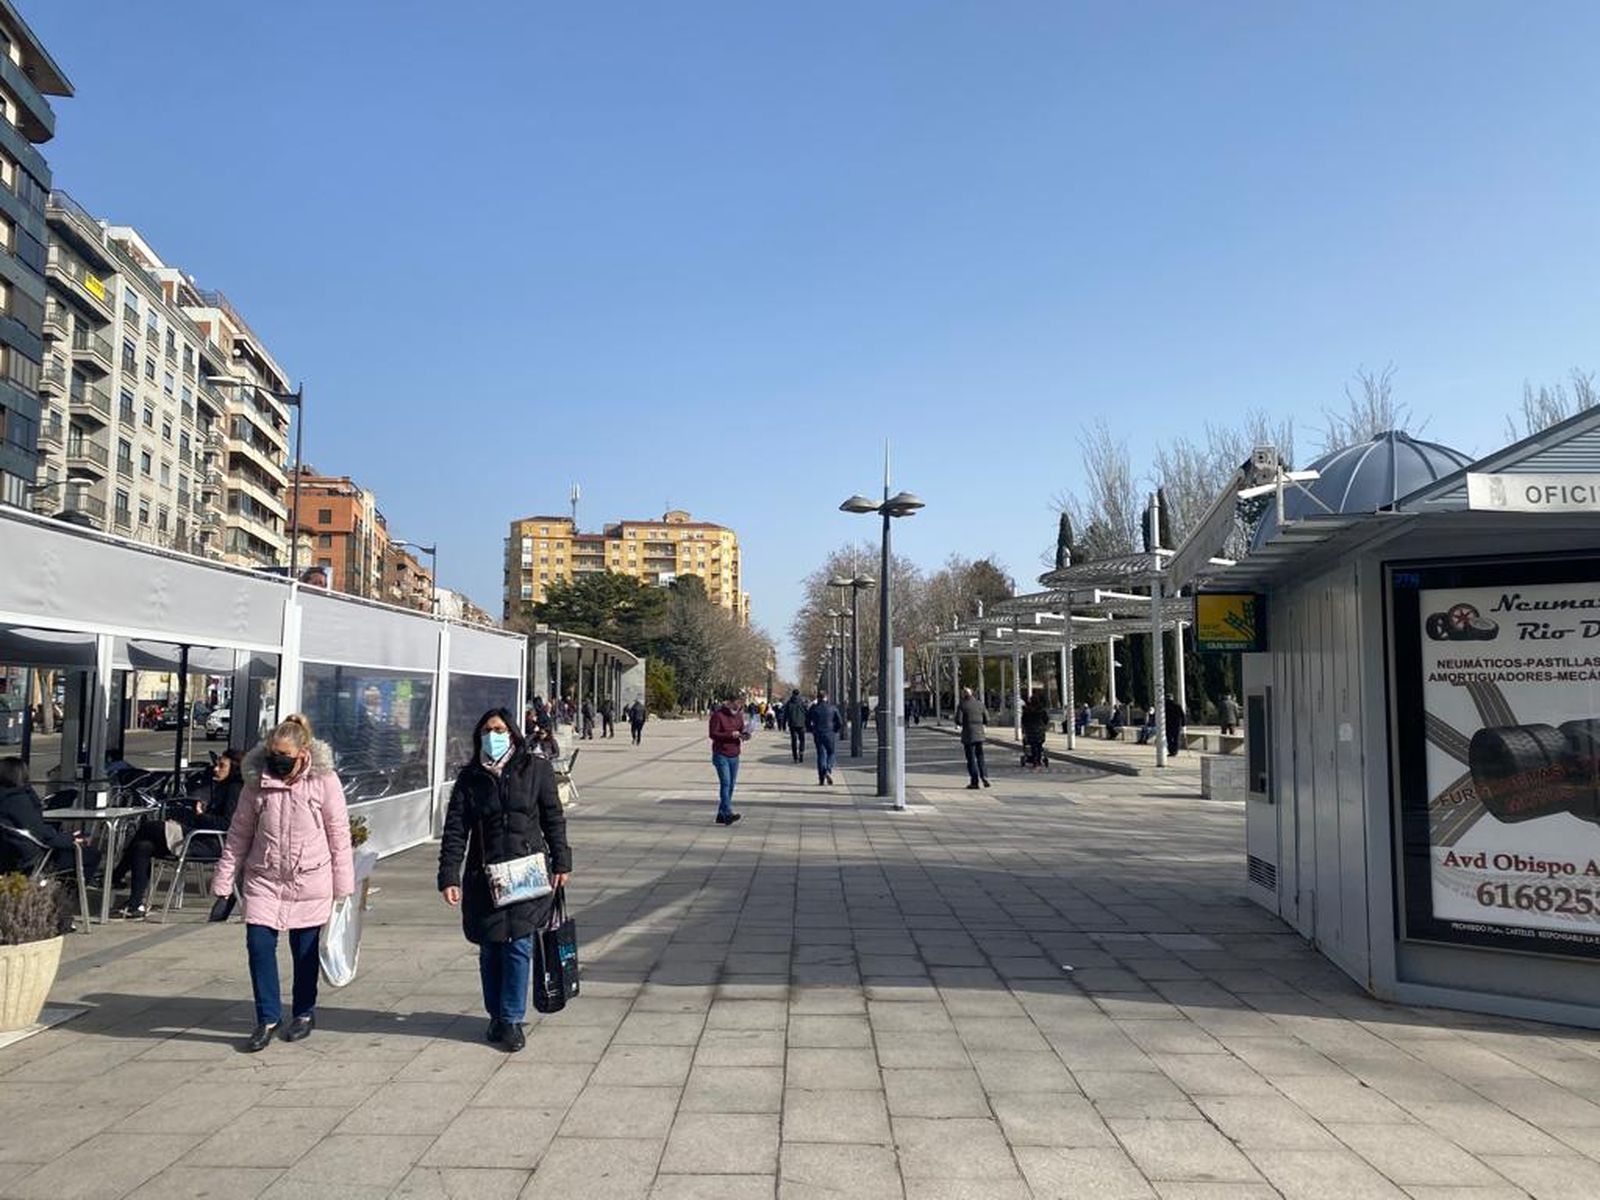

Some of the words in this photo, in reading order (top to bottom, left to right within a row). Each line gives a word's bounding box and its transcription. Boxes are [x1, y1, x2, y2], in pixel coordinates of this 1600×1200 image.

[1525, 485, 1600, 504] OFICI
[1490, 593, 1600, 612] Neuma
[1516, 622, 1576, 640] Rio
[1428, 668, 1600, 682] AMORTIGUADORES-MECÁ
[1443, 851, 1488, 870] Avd
[1493, 854, 1576, 878] Obispo
